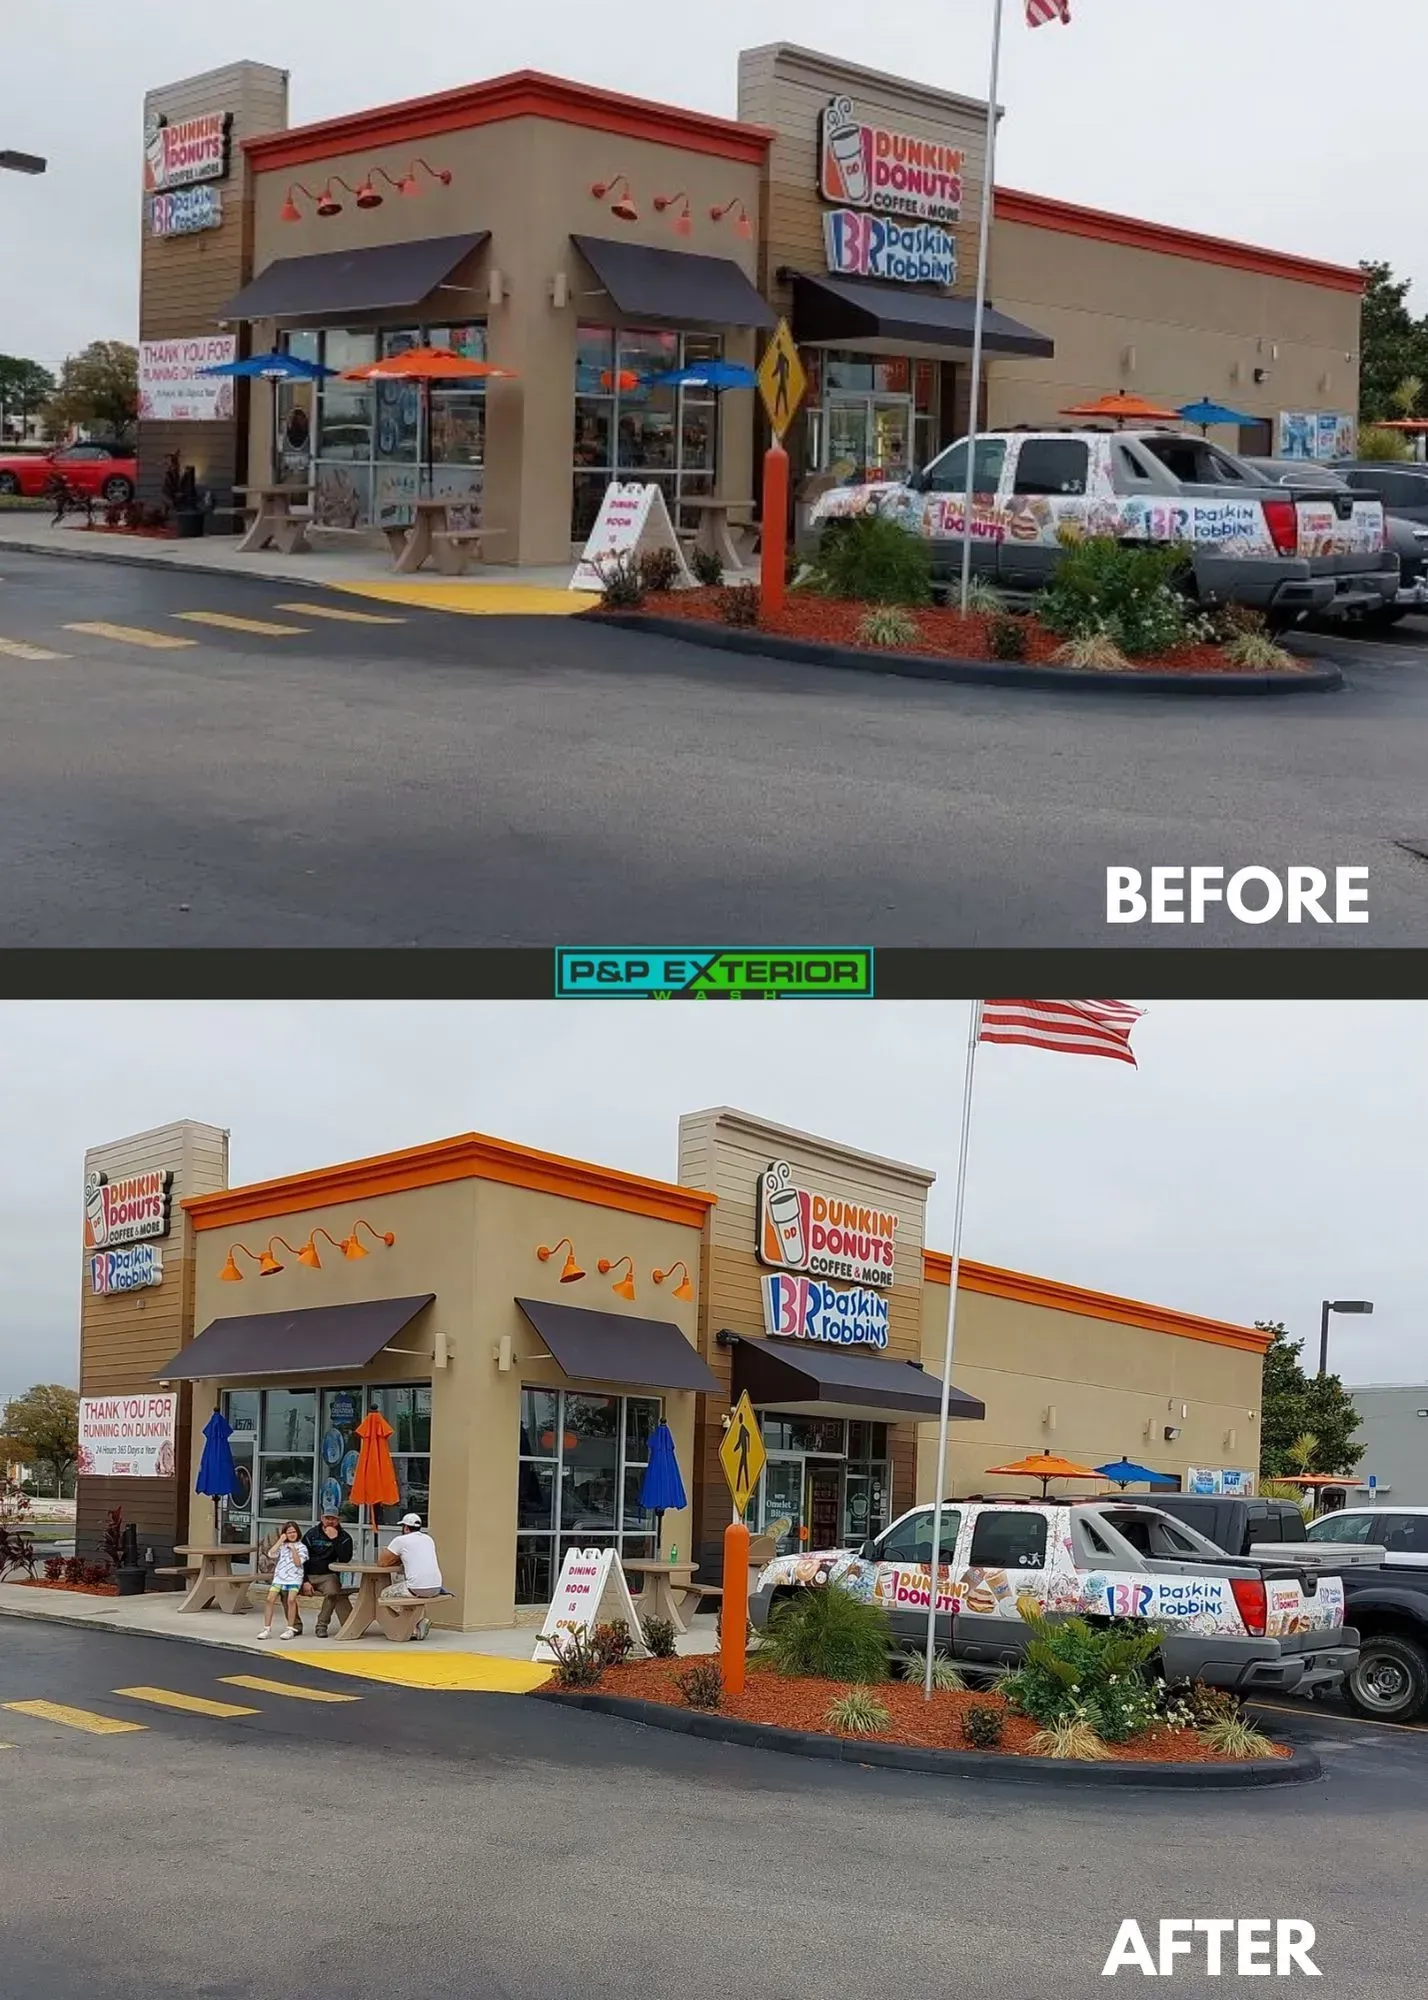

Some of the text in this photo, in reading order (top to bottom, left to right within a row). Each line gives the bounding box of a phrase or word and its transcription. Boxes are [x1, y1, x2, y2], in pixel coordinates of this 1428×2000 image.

[170, 138, 220, 167] DONUTS
[875, 131, 965, 174] DUNKIN'
[875, 160, 962, 203] DONUTS
[873, 192, 918, 213] COFFEE
[928, 205, 961, 223] MORE
[831, 211, 886, 275] BR
[144, 341, 232, 363] THANK YOU FOR
[1145, 507, 1189, 539] BR
[111, 1171, 163, 1204] DUNKIN'
[110, 1195, 160, 1226] DONUTS
[812, 1195, 898, 1239] DUNKIN'
[110, 1227, 134, 1242] COFFEE
[140, 1221, 160, 1236] MORE
[784, 1226, 797, 1240] DD
[812, 1224, 894, 1266] DONUTS
[92, 1254, 116, 1293] BR
[810, 1256, 893, 1286] COFFEE & MORE
[770, 1275, 822, 1337] BR
[84, 1399, 172, 1420] THANK YOU FOR
[84, 1422, 172, 1437] RUNNING ON DUNKIN!
[568, 1567, 597, 1576] DINING
[565, 1584, 590, 1594] ROOM
[1106, 1584, 1154, 1616] BR
[568, 1602, 577, 1611] IS
